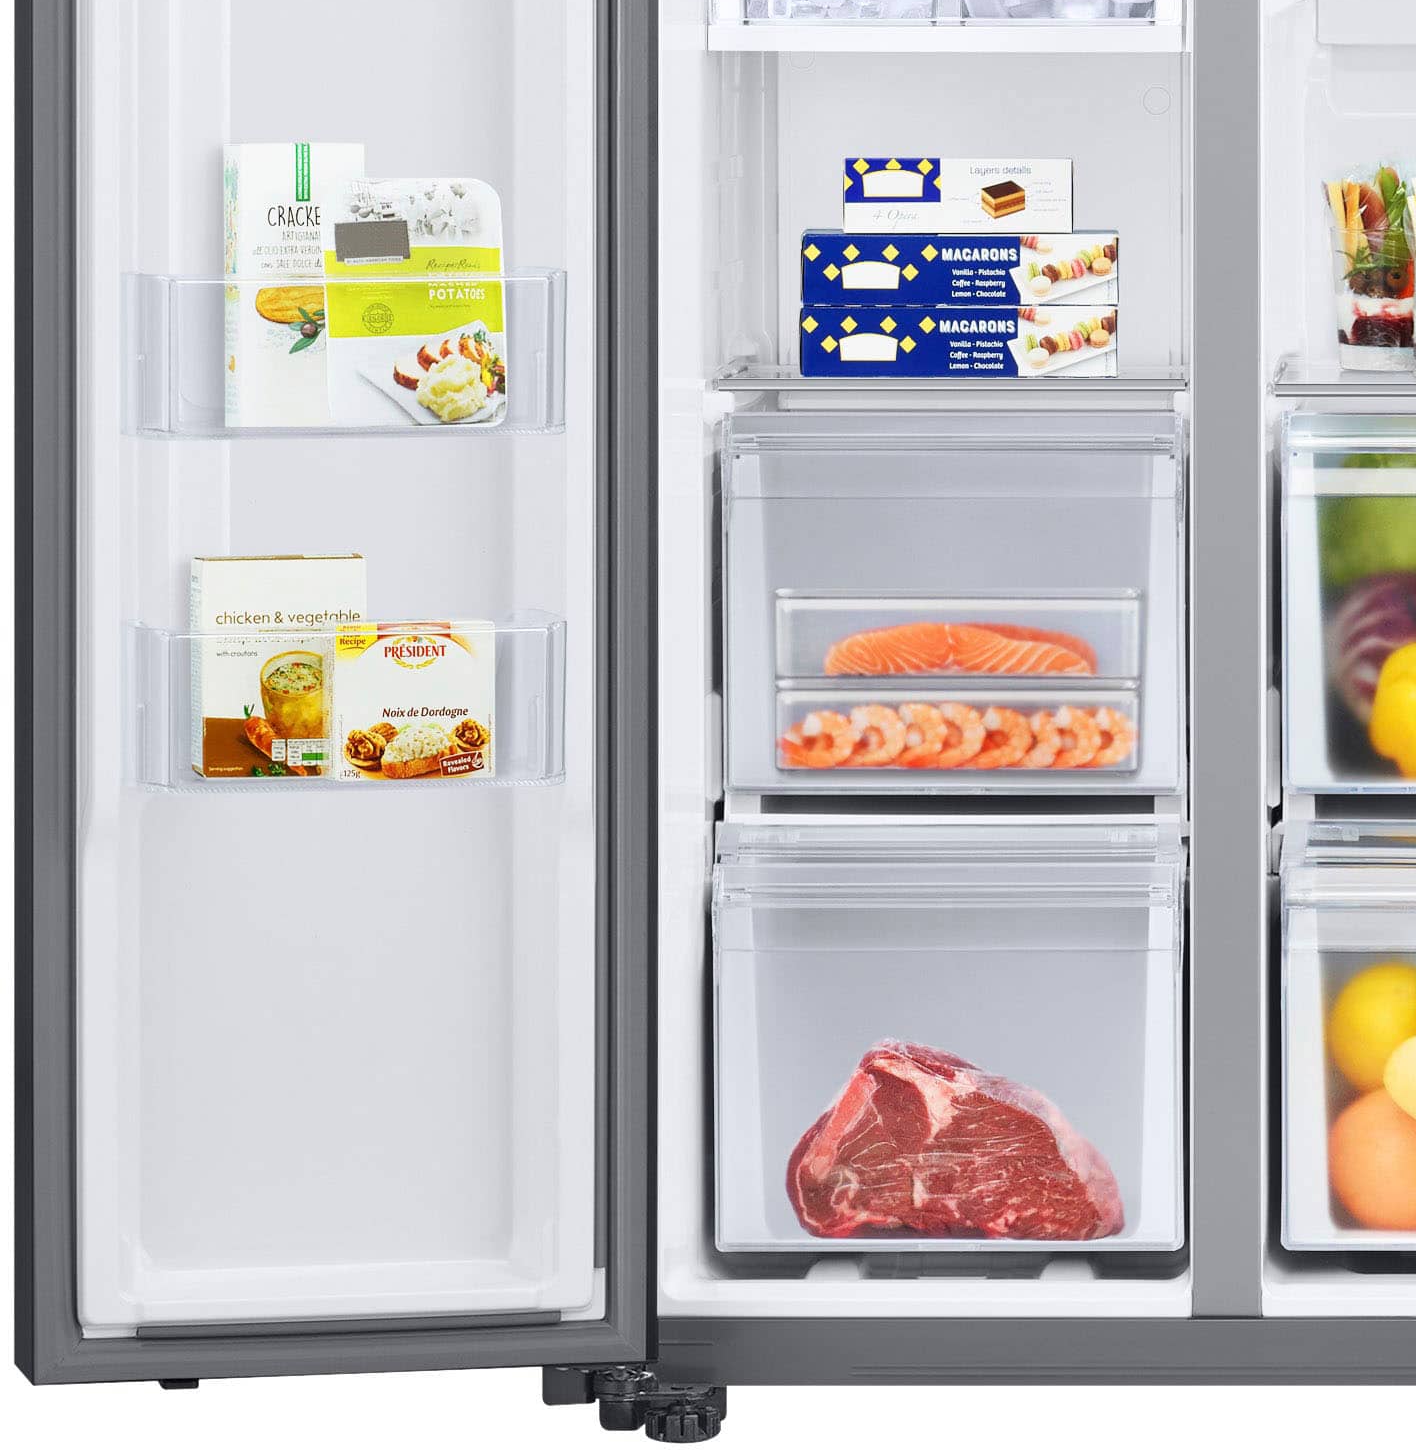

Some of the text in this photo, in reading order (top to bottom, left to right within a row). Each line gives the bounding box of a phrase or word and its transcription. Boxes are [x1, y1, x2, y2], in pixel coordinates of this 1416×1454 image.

[969, 165, 1032, 176] Layers details
[267, 205, 321, 227] CRACKE
[941, 248, 1018, 261] MACARONS
[951, 279, 1006, 288] Coffee Raspberry
[429, 288, 486, 301] POTATOES
[939, 320, 1016, 333] MACARONS
[949, 350, 1004, 360] Coffee Raspberry
[215, 611, 271, 625] chicken
[274, 611, 284, 624] &
[339, 637, 367, 647] Recipe
[384, 643, 447, 660] PRÉSIDENT
[382, 707, 469, 719] Noix de Dordogne
[442, 755, 472, 767] Revealed
